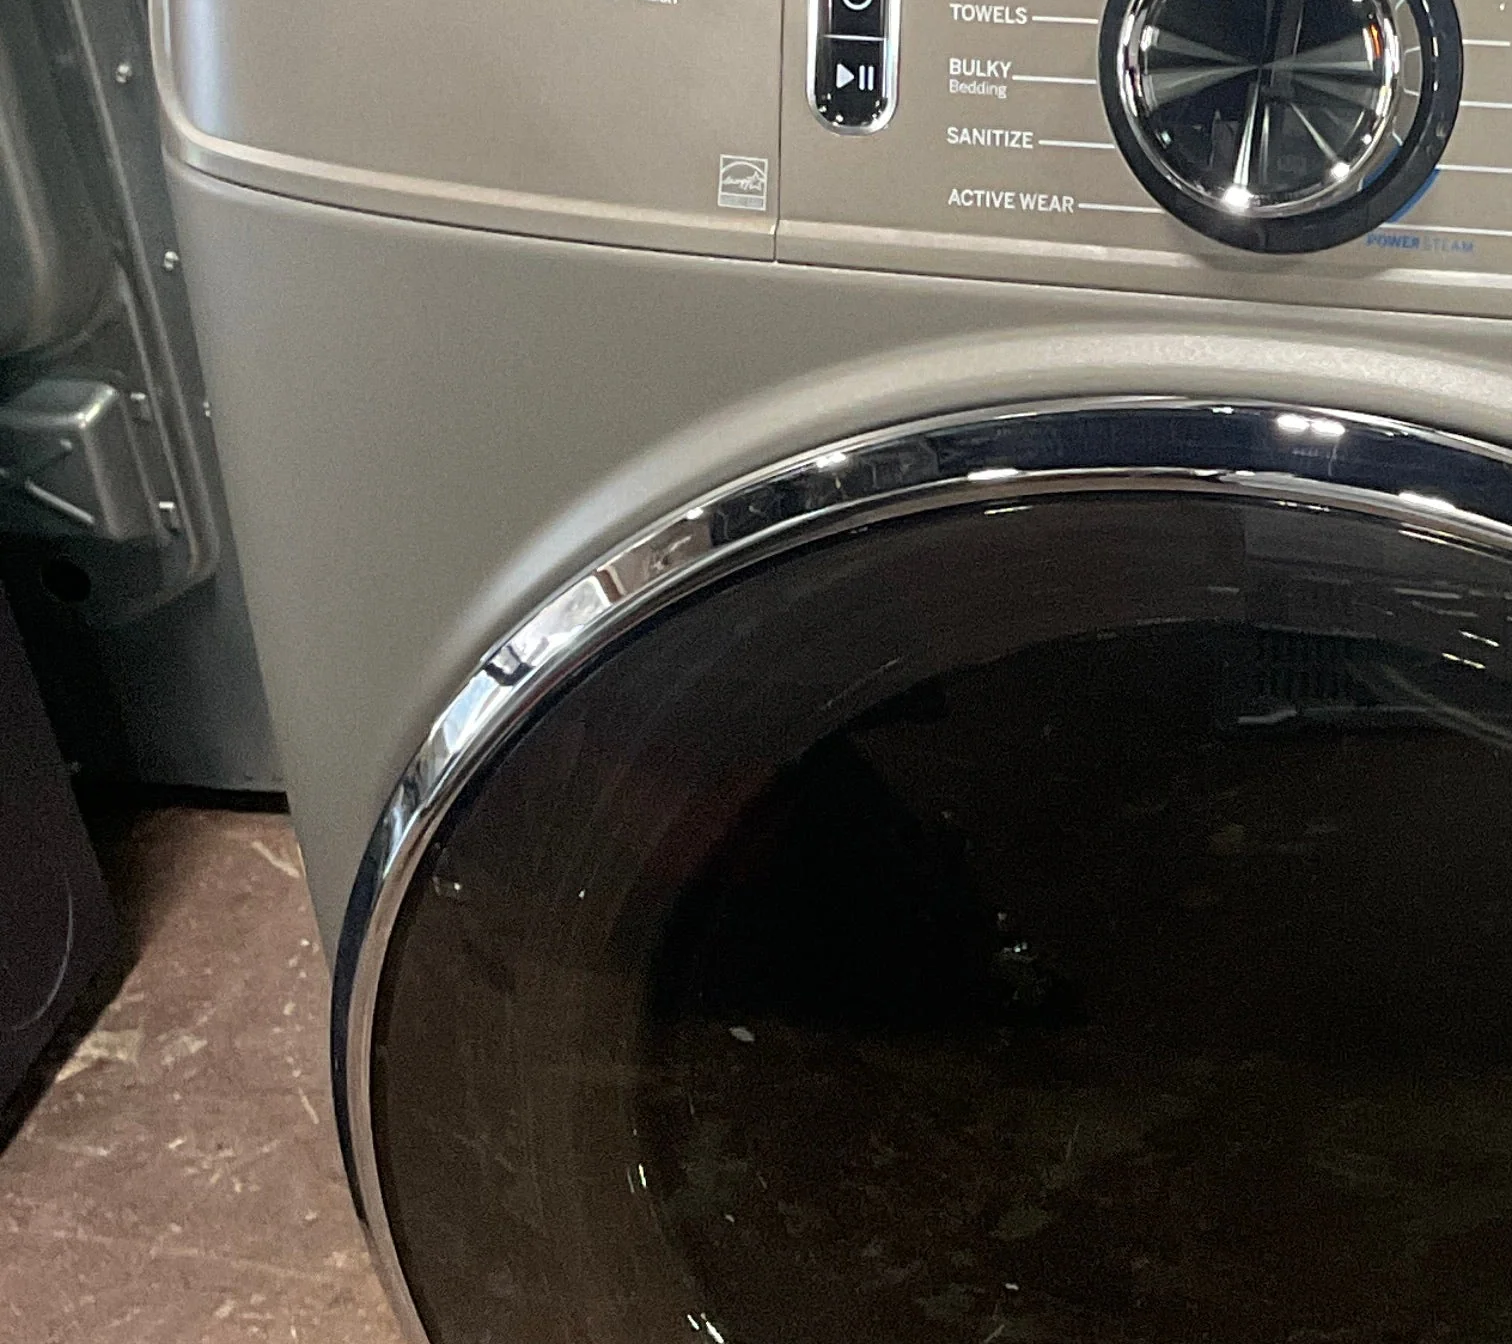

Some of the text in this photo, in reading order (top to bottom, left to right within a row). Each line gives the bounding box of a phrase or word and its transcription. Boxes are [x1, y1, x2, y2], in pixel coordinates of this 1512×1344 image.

[949, 3, 1028, 25] TOWELS
[949, 57, 1012, 77] BULKY
[949, 79, 1008, 99] Bedding
[946, 127, 1034, 149] SANITIZE
[948, 188, 1075, 213] ACTIVE WEAR
[1366, 234, 1419, 250] POWER
